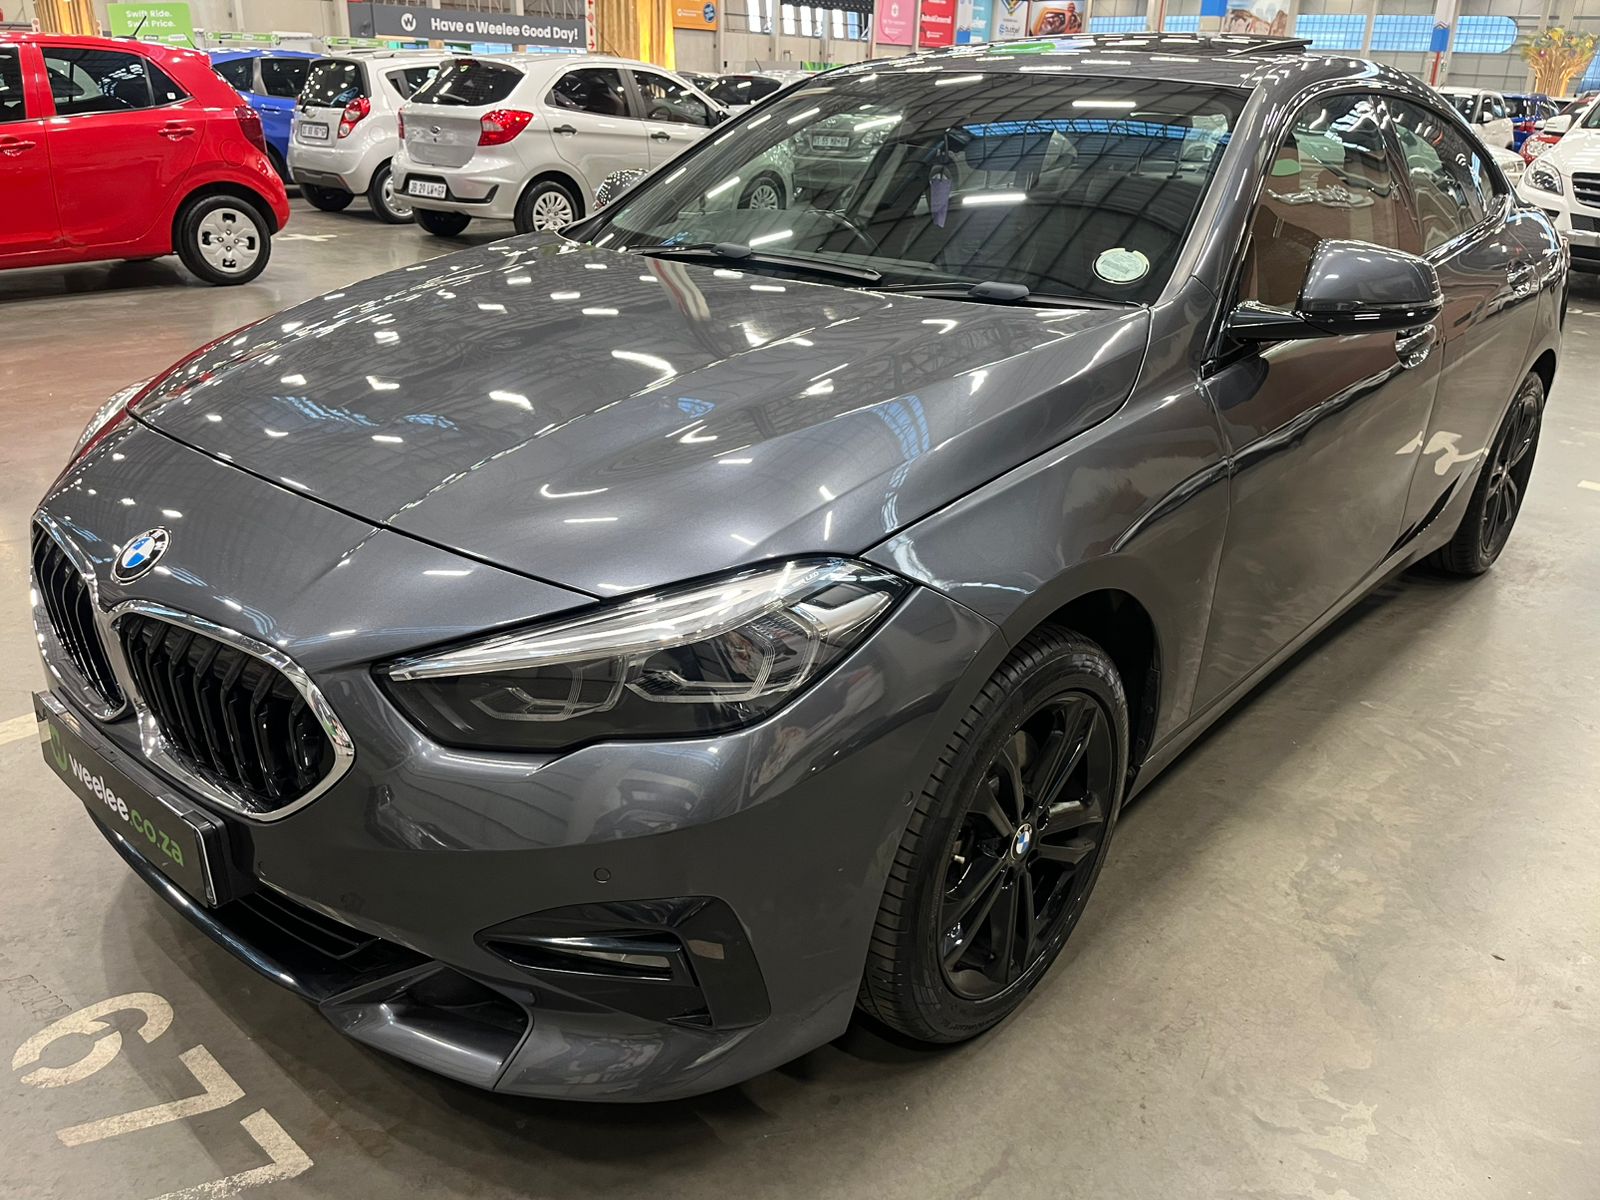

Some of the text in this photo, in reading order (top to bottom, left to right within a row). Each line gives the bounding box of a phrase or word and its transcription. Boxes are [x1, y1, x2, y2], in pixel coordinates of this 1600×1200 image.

[126, 10, 147, 18] Swift
[431, 17, 578, 43] Have a Weelee Good Day!
[69, 753, 184, 867] weelee.co.za
